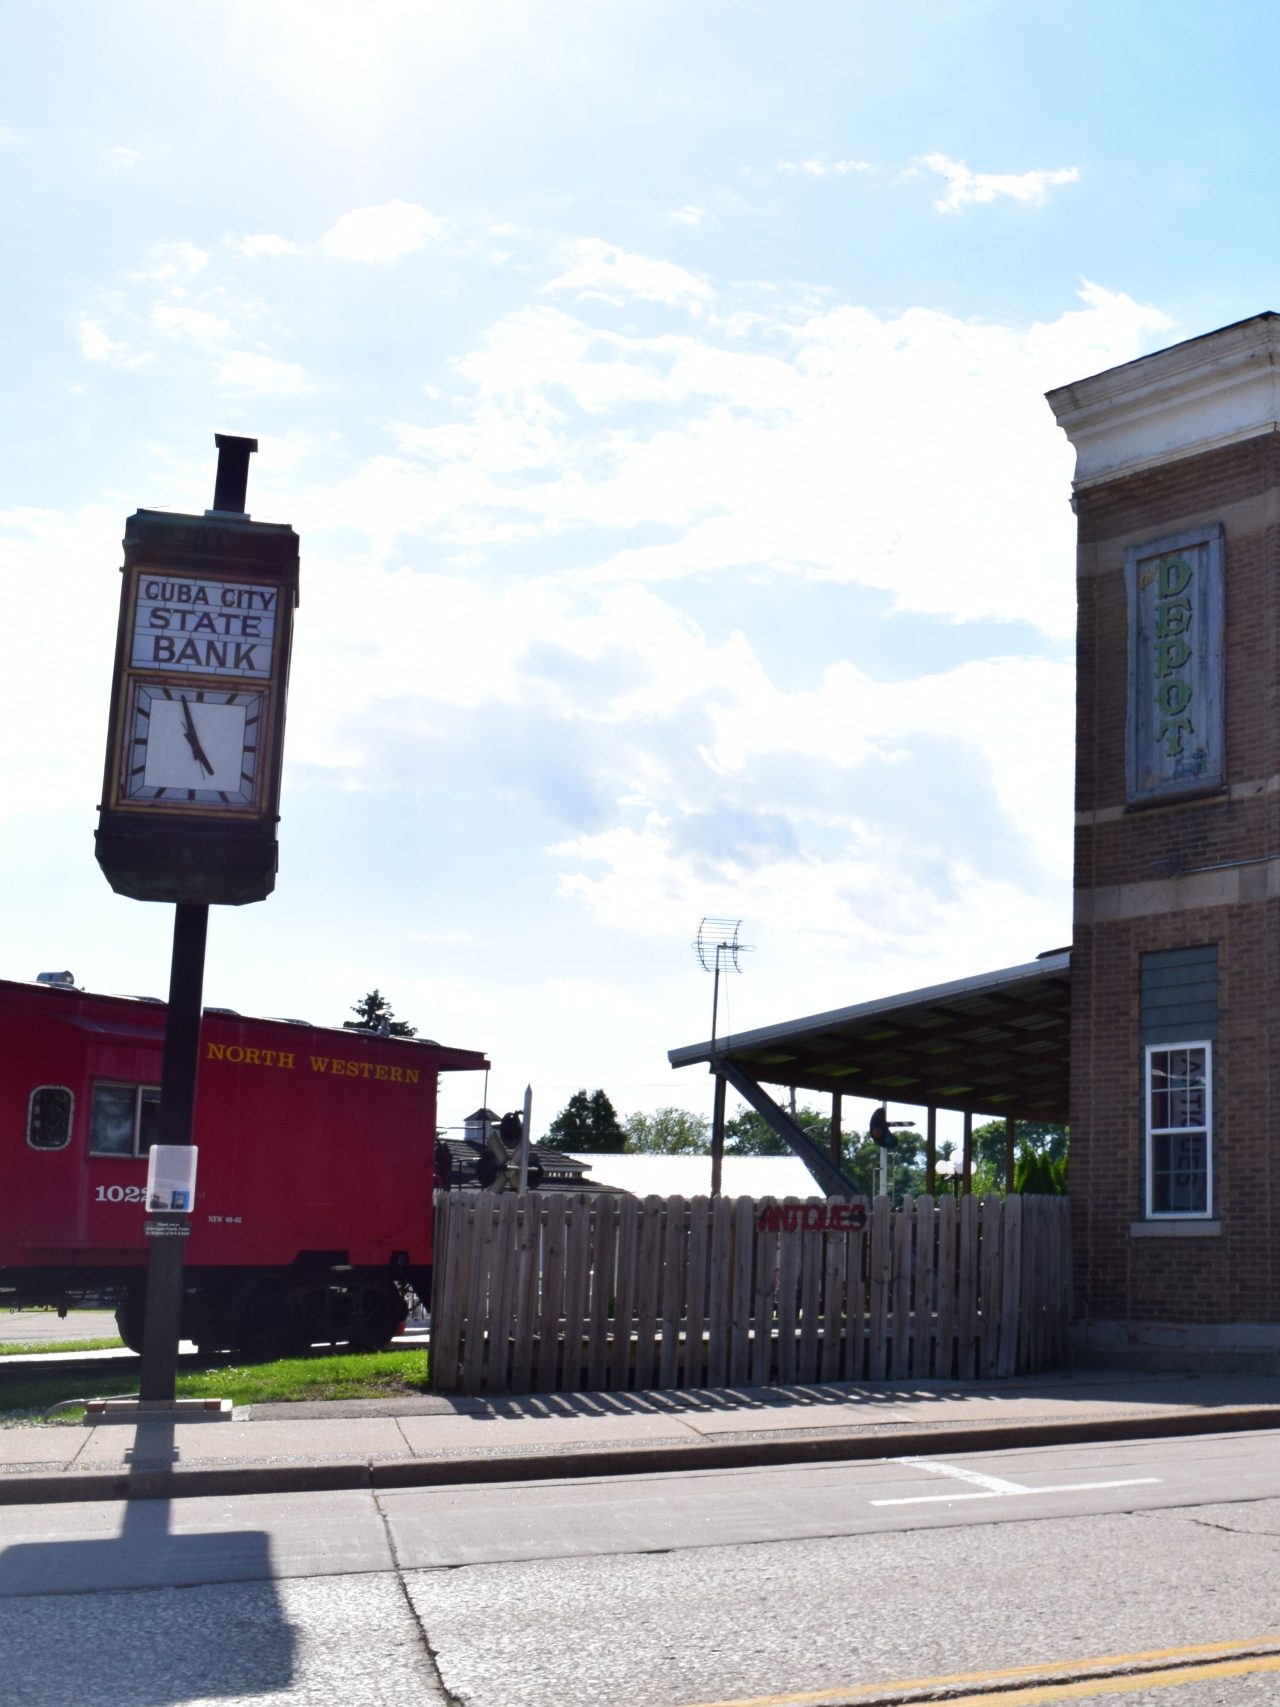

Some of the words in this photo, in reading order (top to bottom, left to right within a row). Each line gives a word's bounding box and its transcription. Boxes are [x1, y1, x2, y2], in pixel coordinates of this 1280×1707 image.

[145, 580, 209, 605] CUBA
[221, 588, 275, 611] CITY
[150, 607, 262, 637] STATE
[153, 635, 258, 670] BANK
[1154, 556, 1194, 758] DEPOT
[206, 1043, 294, 1069] NORTH
[310, 1057, 420, 1084] WESTERN
